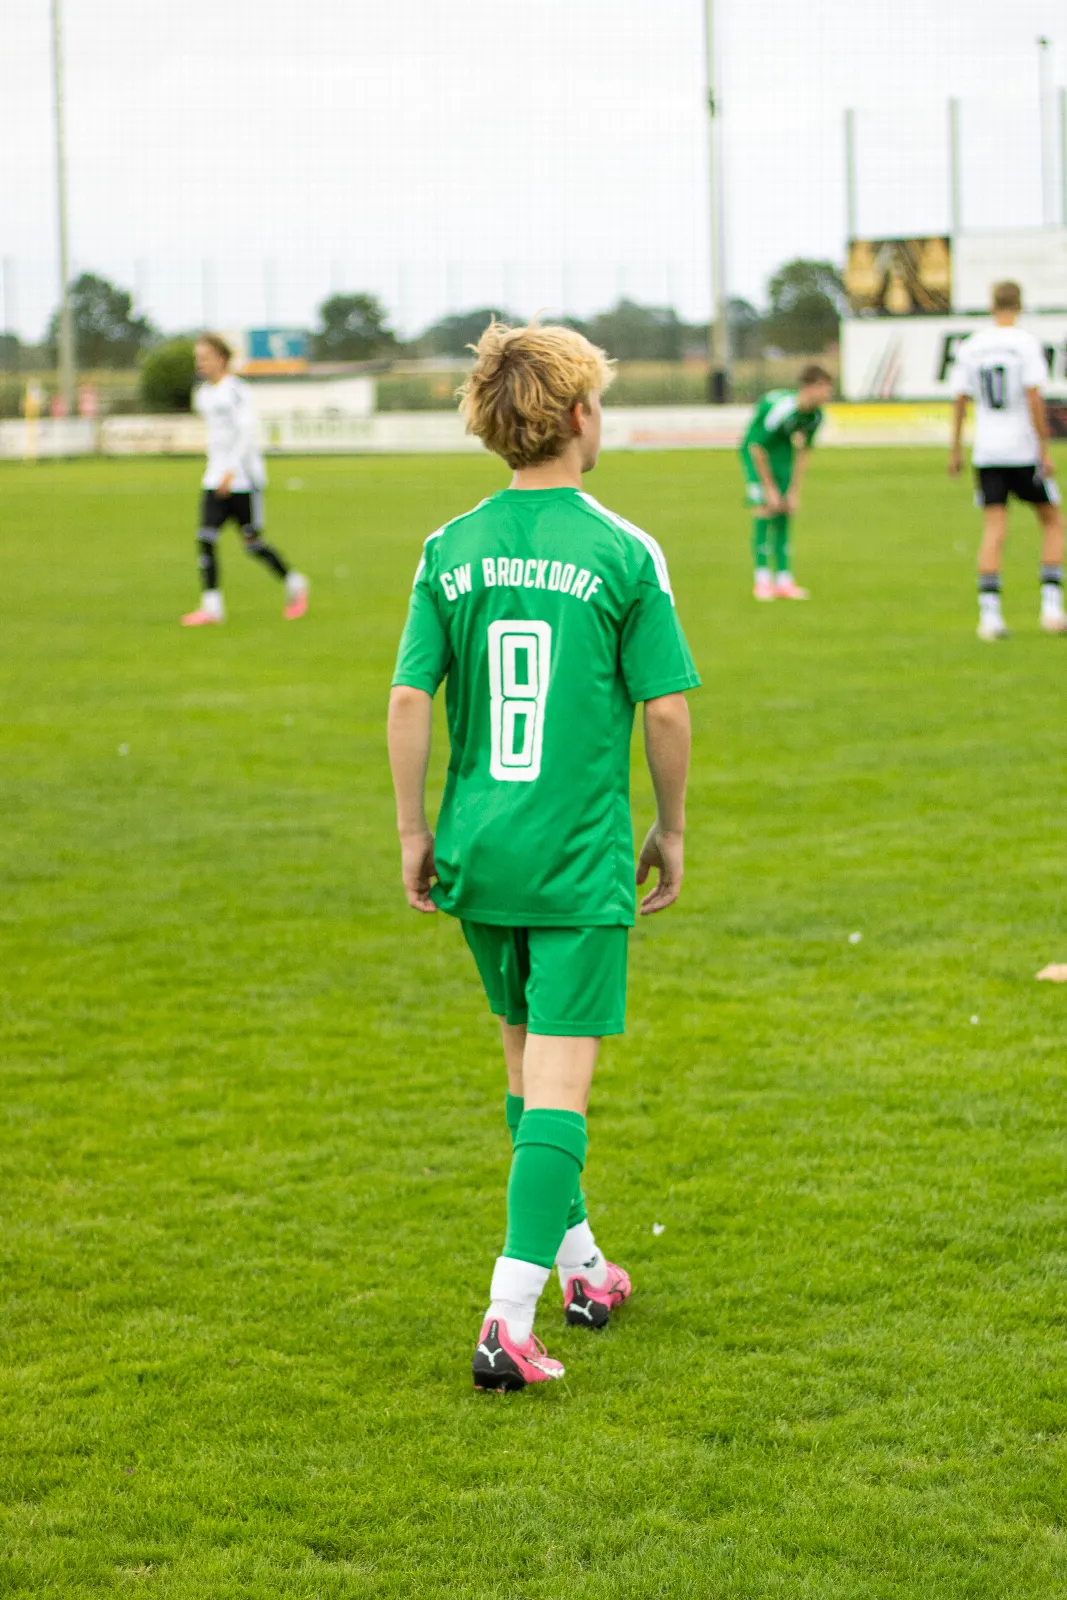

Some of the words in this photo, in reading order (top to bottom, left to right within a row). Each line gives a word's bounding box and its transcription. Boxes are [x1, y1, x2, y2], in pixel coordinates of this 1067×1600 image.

[440, 564, 472, 601] GW
[482, 557, 602, 602] BROCKDORF
[487, 619, 552, 781] 8
